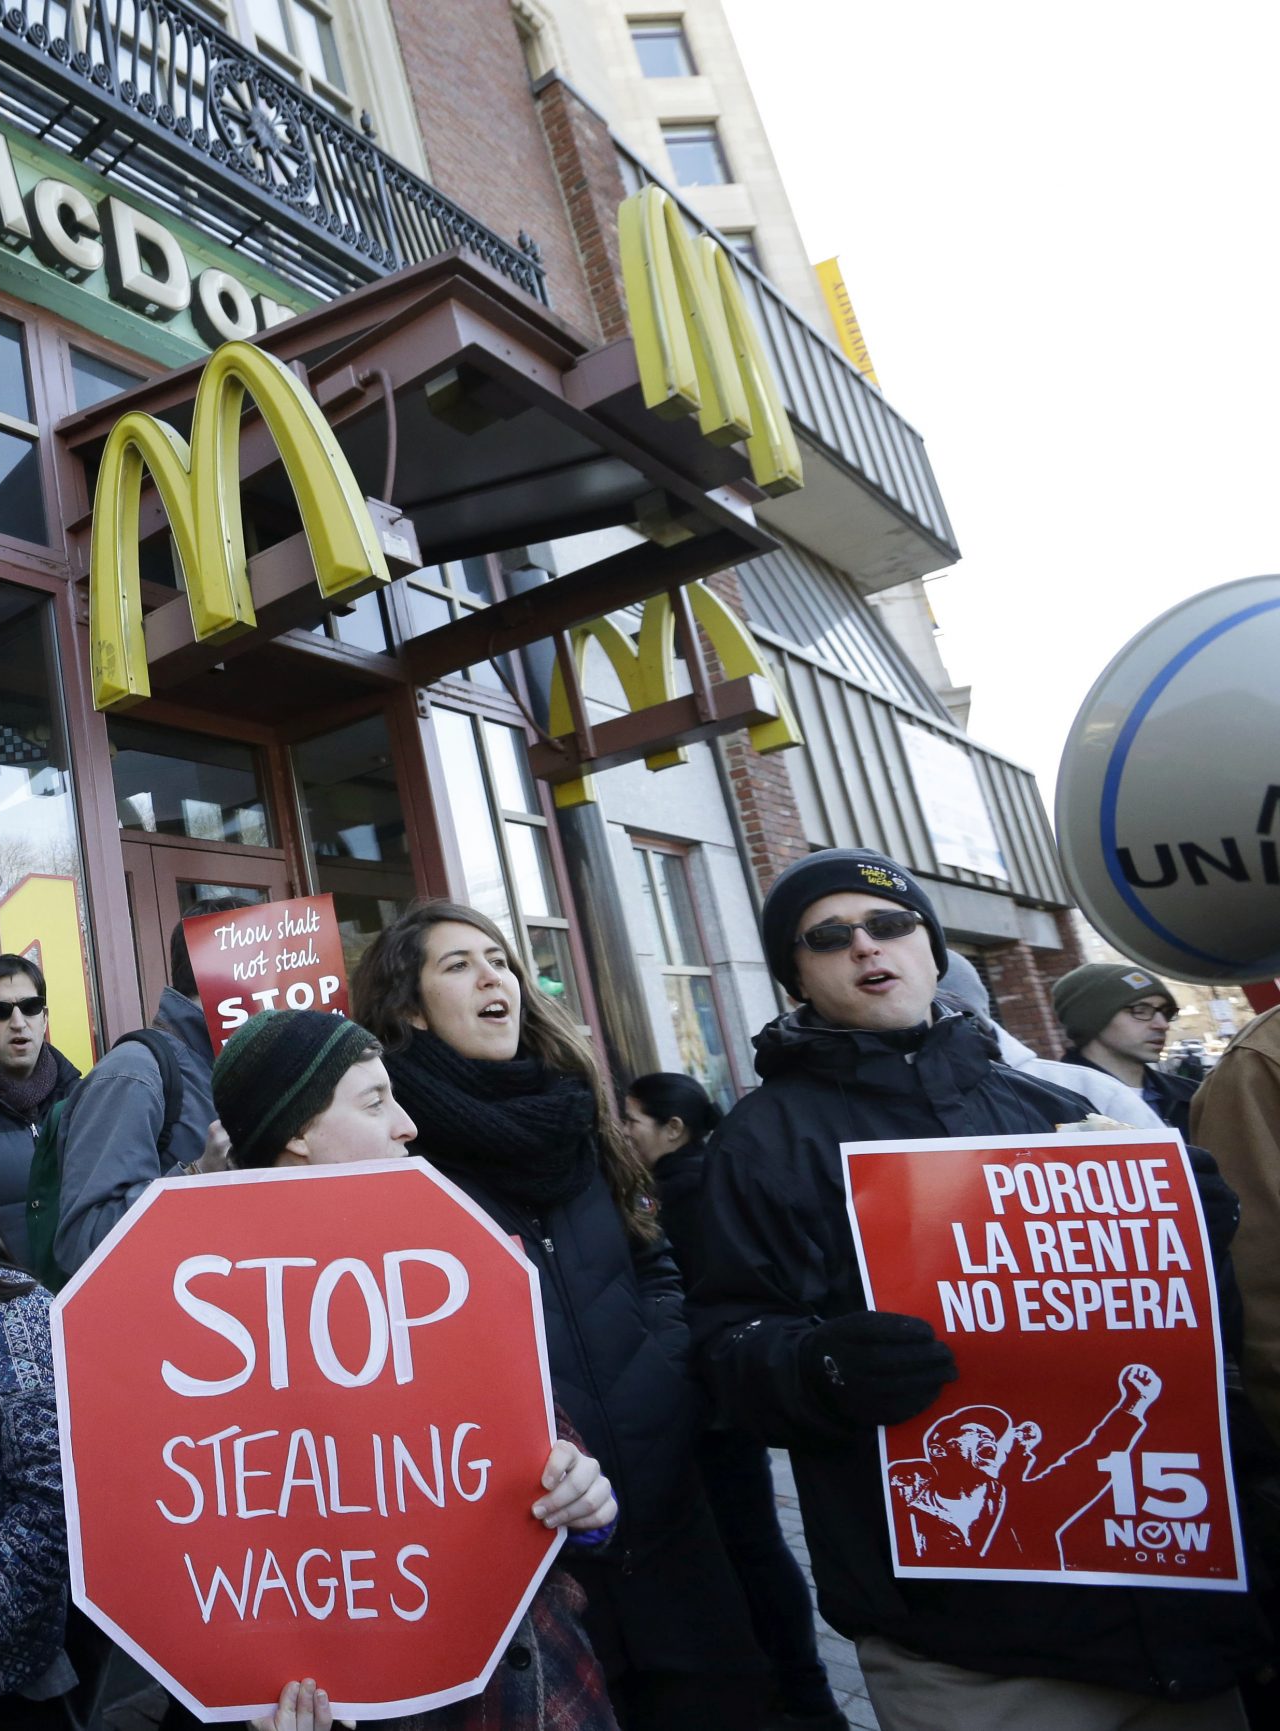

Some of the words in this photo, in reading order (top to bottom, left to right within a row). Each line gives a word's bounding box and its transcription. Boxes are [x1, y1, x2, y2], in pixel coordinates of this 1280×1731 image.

[214, 922, 273, 951] Thou
[277, 906, 321, 939] shalt
[232, 950, 270, 981] not
[275, 938, 321, 972] steal.
[217, 975, 341, 1030] STOP
[982, 1158, 1179, 1216] PORQUE
[951, 1221, 1020, 1275] LA
[1024, 1218, 1192, 1274] RENTA
[161, 1249, 470, 1397] STOP
[936, 1279, 1006, 1333] NO
[1012, 1277, 1198, 1332] ESPERA
[156, 1423, 492, 1525] STEALING
[1096, 1451, 1208, 1519] 15
[1104, 1518, 1211, 1552] NOW
[183, 1543, 430, 1624] WAGES
